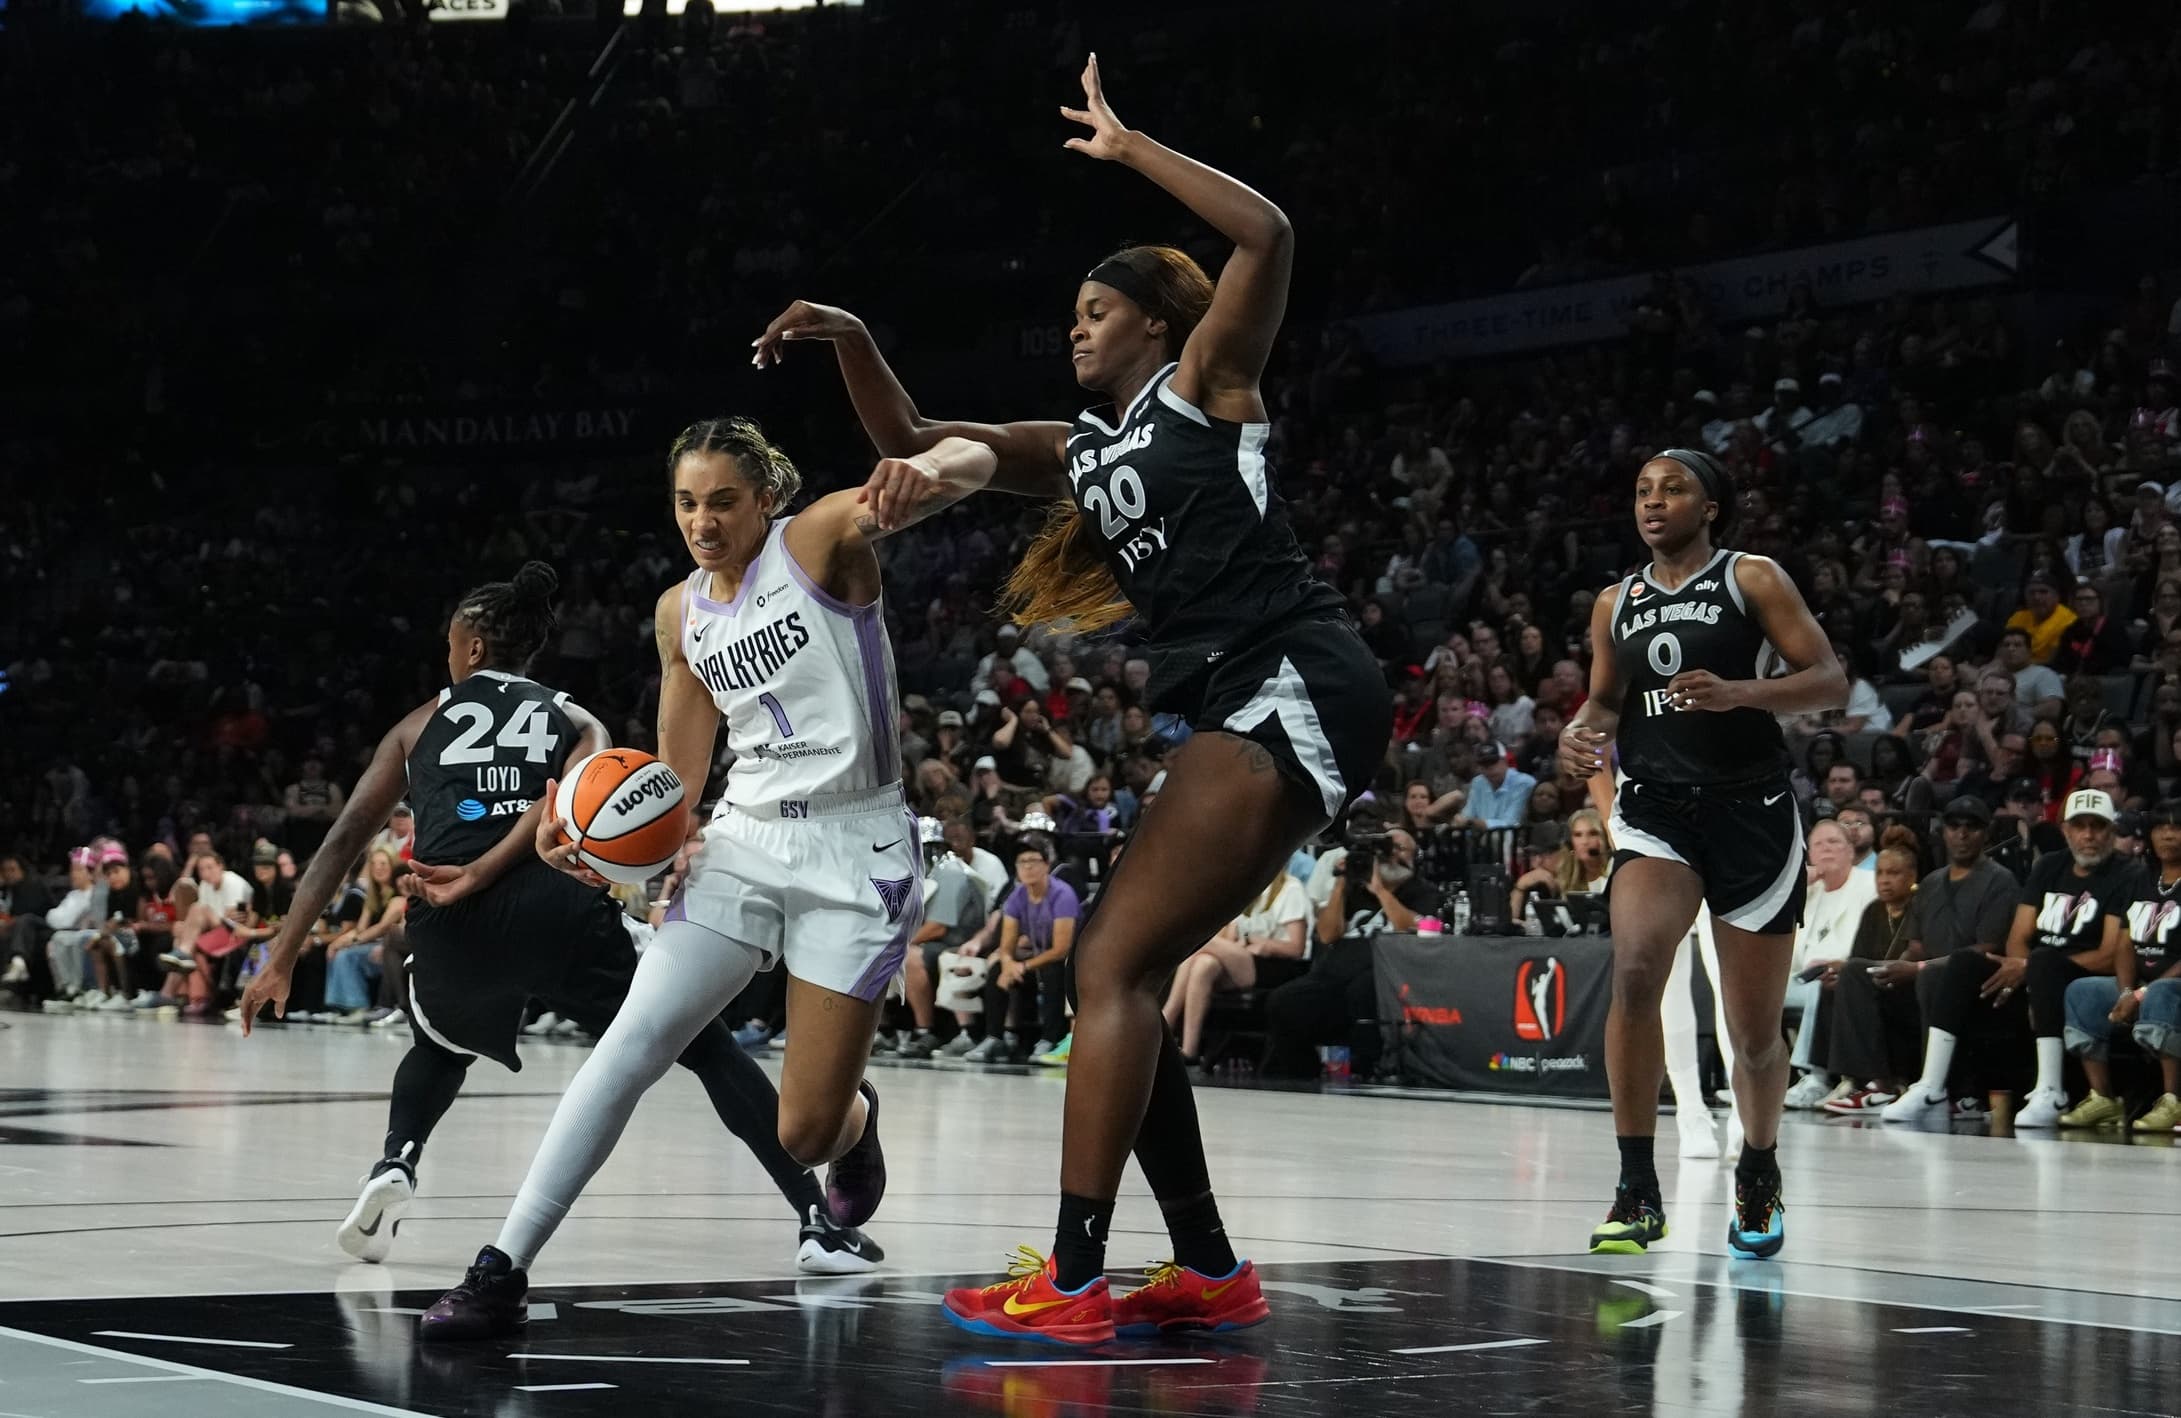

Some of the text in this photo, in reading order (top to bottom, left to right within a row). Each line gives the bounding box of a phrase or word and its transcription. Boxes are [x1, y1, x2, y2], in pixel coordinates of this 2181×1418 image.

[1743, 255, 1889, 298] CHMPS
[359, 407, 633, 447] MANDALAY BAY
[1084, 465, 1147, 540] 20
[765, 583, 789, 602] freedom
[1695, 579, 1720, 592] ally
[1620, 601, 1722, 641] LAS VEGAS
[695, 611, 810, 693] VALKYRIES
[1647, 632, 1682, 677] 0
[439, 700, 559, 766] 24
[758, 691, 794, 739] 1
[778, 741, 808, 752] KAISER
[782, 746, 842, 760] PERMANENTE
[476, 766, 521, 793] LOYD
[611, 766, 681, 816] Wilson
[780, 800, 808, 819] GSV
[2074, 793, 2104, 809] FIF
[2036, 889, 2099, 935] MVP
[1510, 1057, 1536, 1072] NBC
